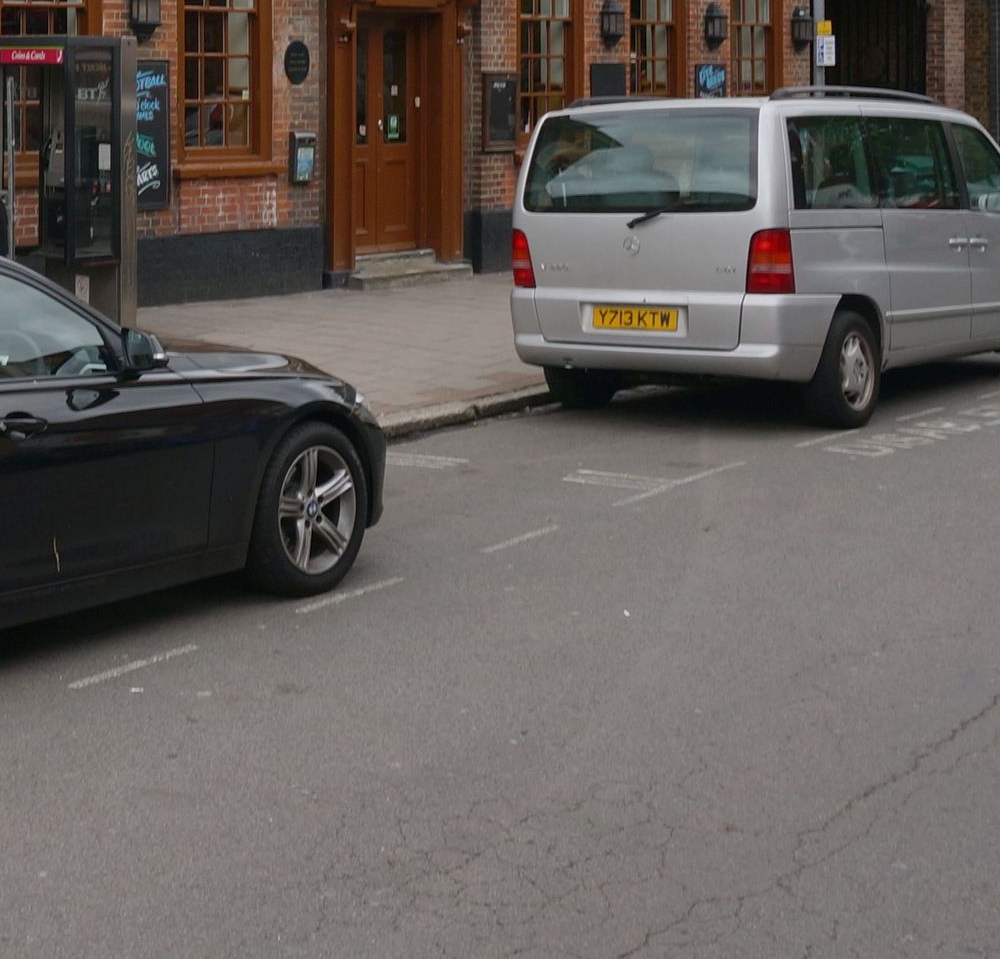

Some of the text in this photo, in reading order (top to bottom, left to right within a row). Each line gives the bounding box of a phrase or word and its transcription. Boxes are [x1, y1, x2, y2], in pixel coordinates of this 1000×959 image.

[78, 87, 98, 100] BT
[599, 308, 670, 327] Y713 KTW
